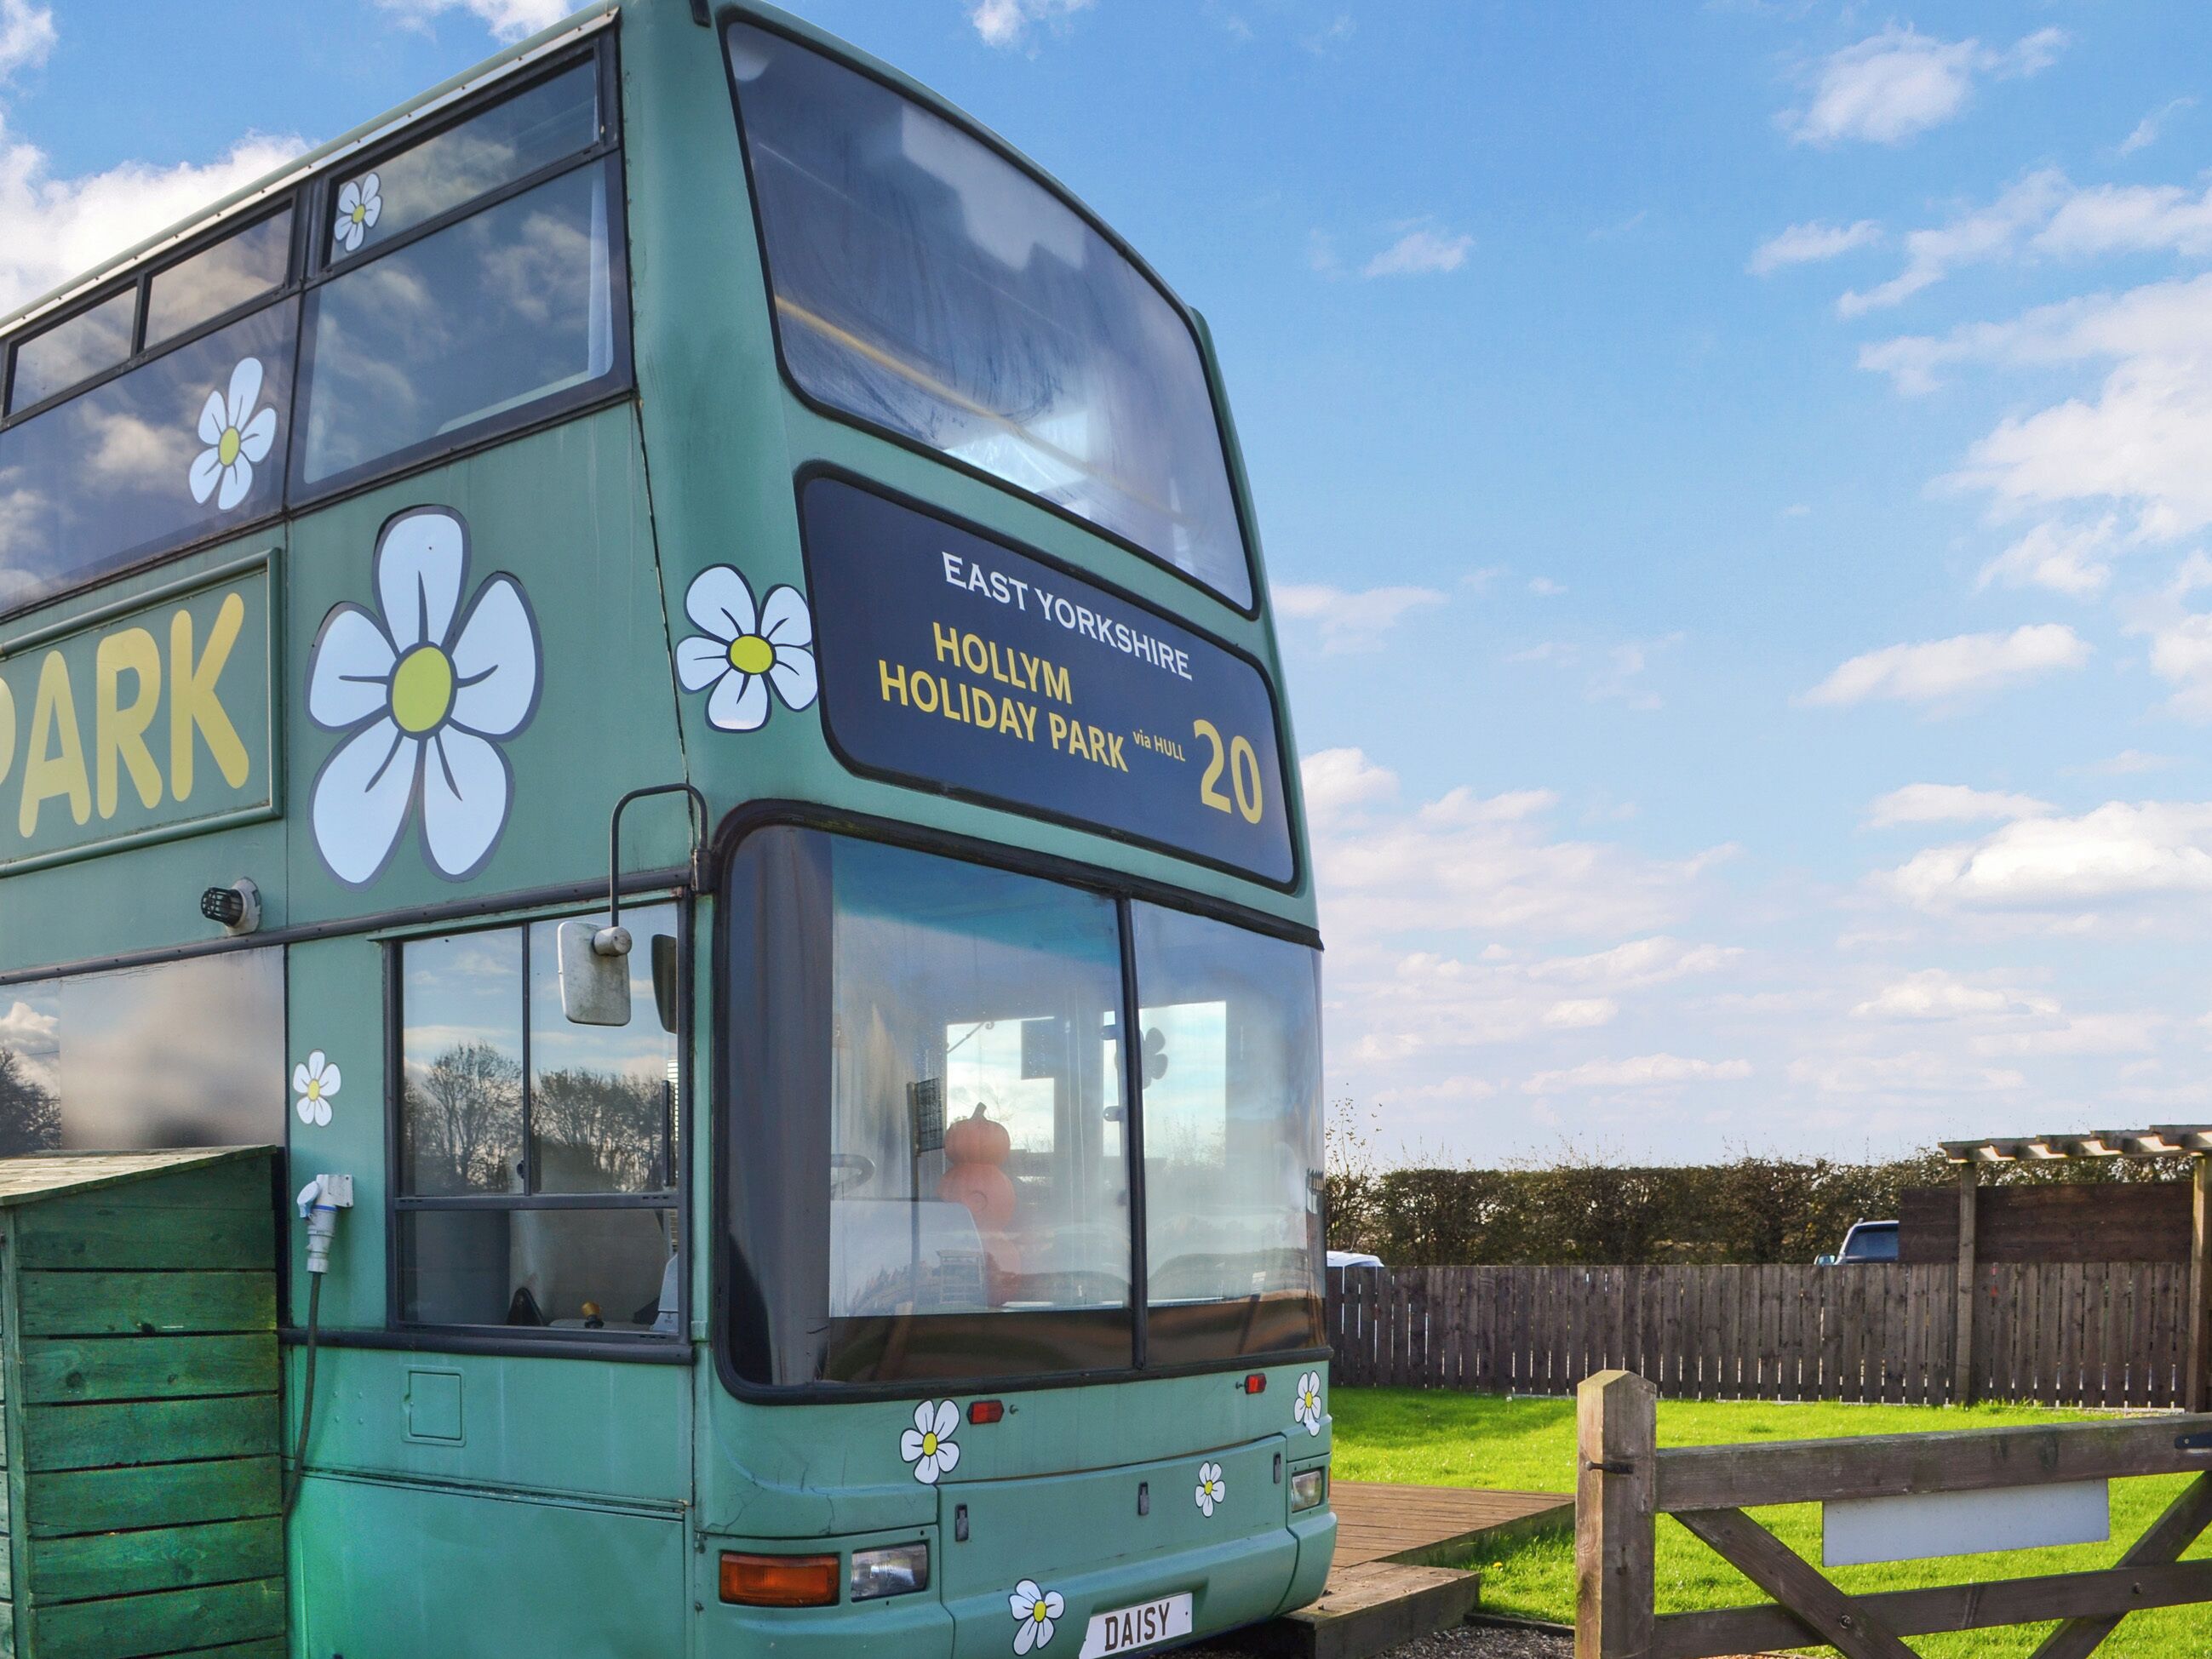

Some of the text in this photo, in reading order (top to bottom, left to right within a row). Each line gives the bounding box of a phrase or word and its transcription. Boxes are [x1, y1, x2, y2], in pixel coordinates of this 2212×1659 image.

[932, 622, 1073, 705] HOLLYM
[942, 552, 1193, 681] EAST YORKSHIRE
[0, 592, 249, 838] ARK
[879, 660, 1129, 773] HOLIDAY PARK
[1132, 729, 1186, 762] via HULL
[1194, 719, 1263, 824] 20
[1104, 1602, 1170, 1651] DAISY
